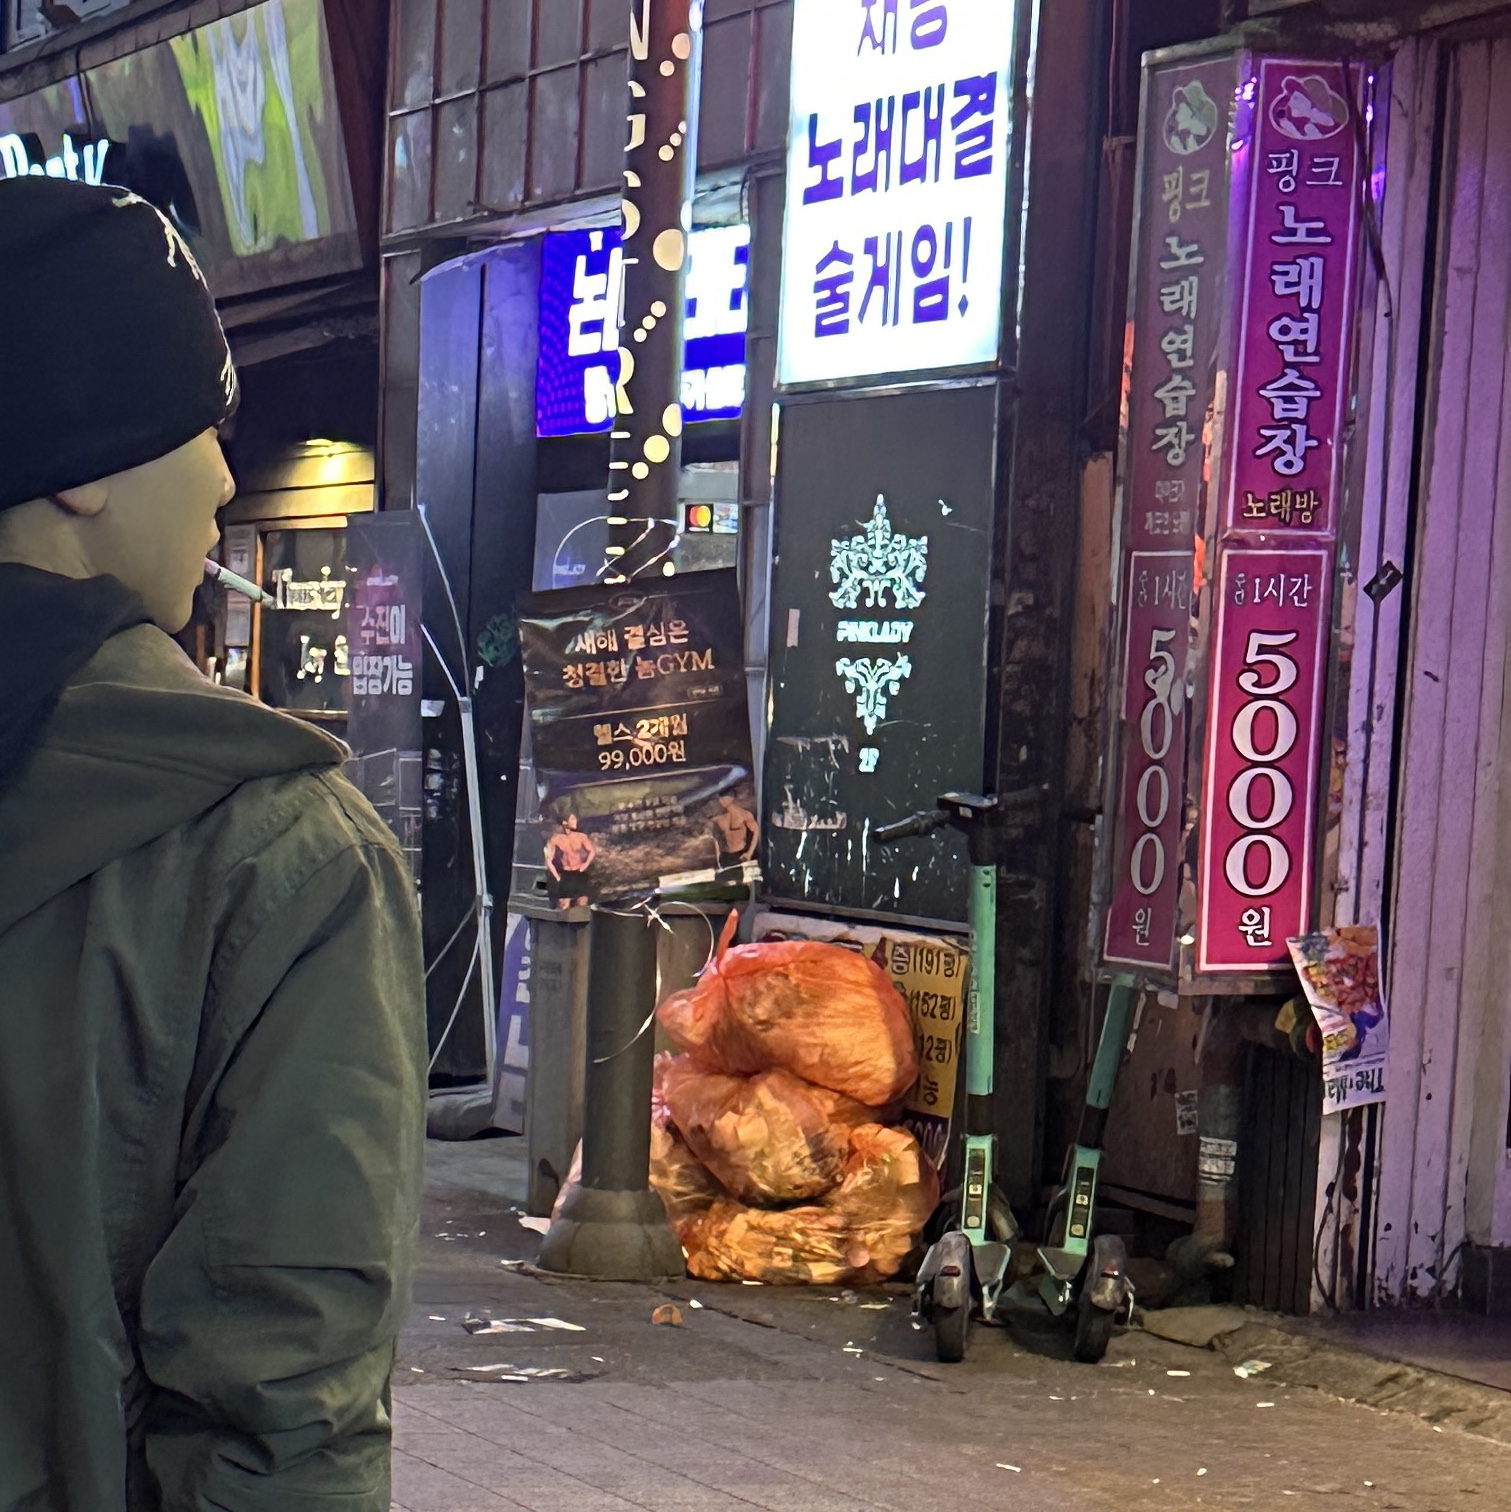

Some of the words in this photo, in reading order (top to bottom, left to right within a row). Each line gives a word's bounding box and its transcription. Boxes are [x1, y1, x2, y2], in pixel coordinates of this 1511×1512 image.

[802, 71, 998, 206] 노래대결
[1266, 148, 1344, 193] 핑크
[1162, 165, 1211, 223] 핑크
[813, 216, 972, 338] 술게임!
[1152, 235, 1205, 467] 노래연습장
[1256, 204, 1332, 477] 노래연습장
[1242, 491, 1318, 524] 노래방
[1253, 572, 1314, 608] 1시간
[573, 628, 619, 655] 새해
[624, 619, 690, 651] 결심은
[837, 620, 914, 643] PINKLADY
[598, 739, 687, 772] 99,000원
